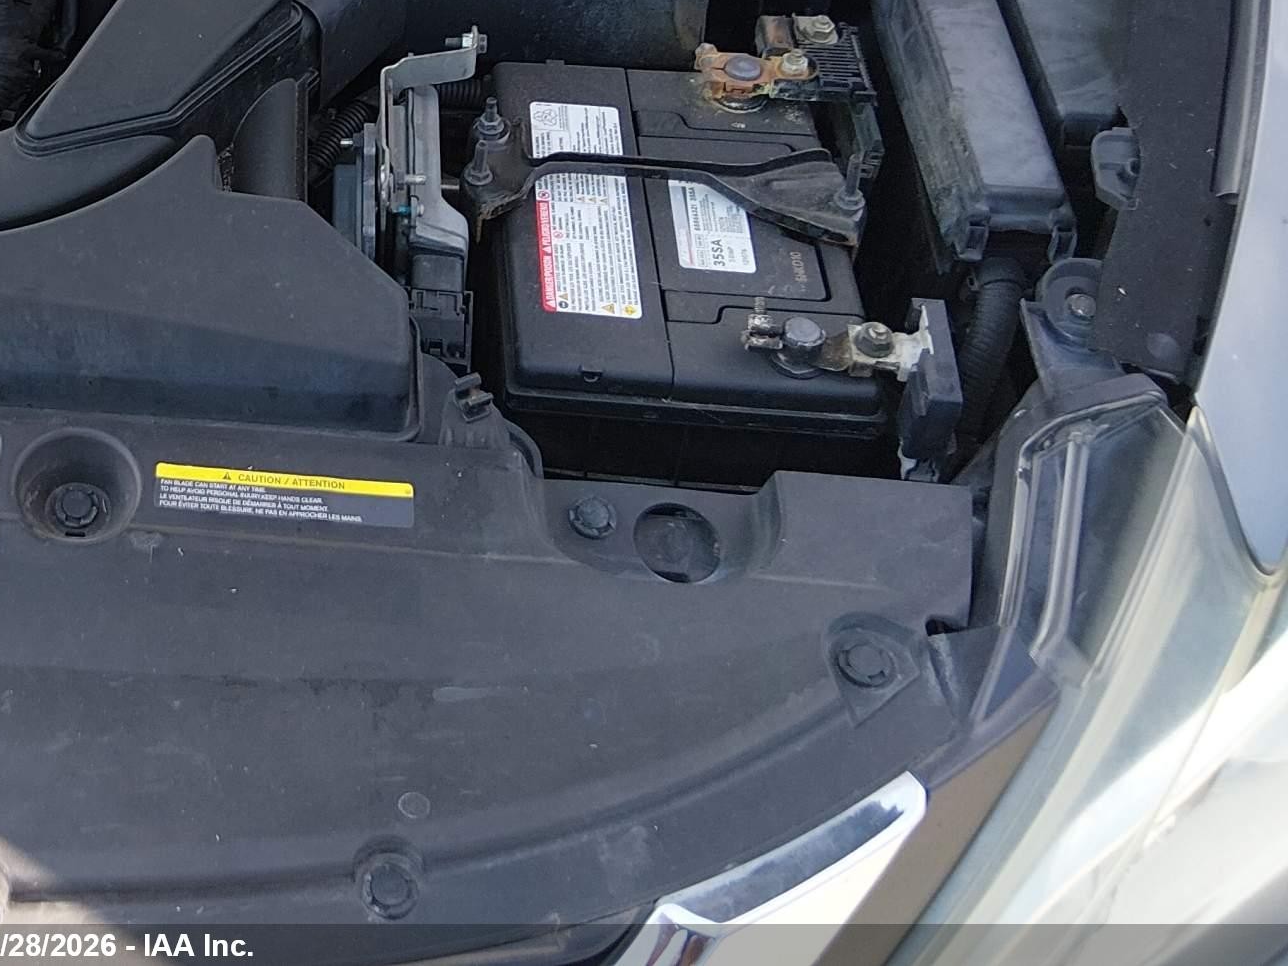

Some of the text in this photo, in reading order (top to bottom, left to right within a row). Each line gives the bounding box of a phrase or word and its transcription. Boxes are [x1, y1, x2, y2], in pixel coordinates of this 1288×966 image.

[710, 239, 726, 267] 35SA
[237, 473, 281, 485] CAUTION
[291, 478, 345, 490] ATTENTION
[186, 487, 206, 495] AVOID
[206, 488, 239, 497] PERSONAL
[159, 499, 178, 507] POUR
[178, 499, 199, 509] ÉVITER
[200, 503, 219, 511] TOUTE
[264, 508, 278, 516] PAS
[288, 510, 328, 520] APPROCHER
[328, 513, 340, 521] LES
[168, 493, 208, 503] VENTILATEUR
[208, 496, 232, 505] RISQUE
[282, 502, 299, 510] TOUT
